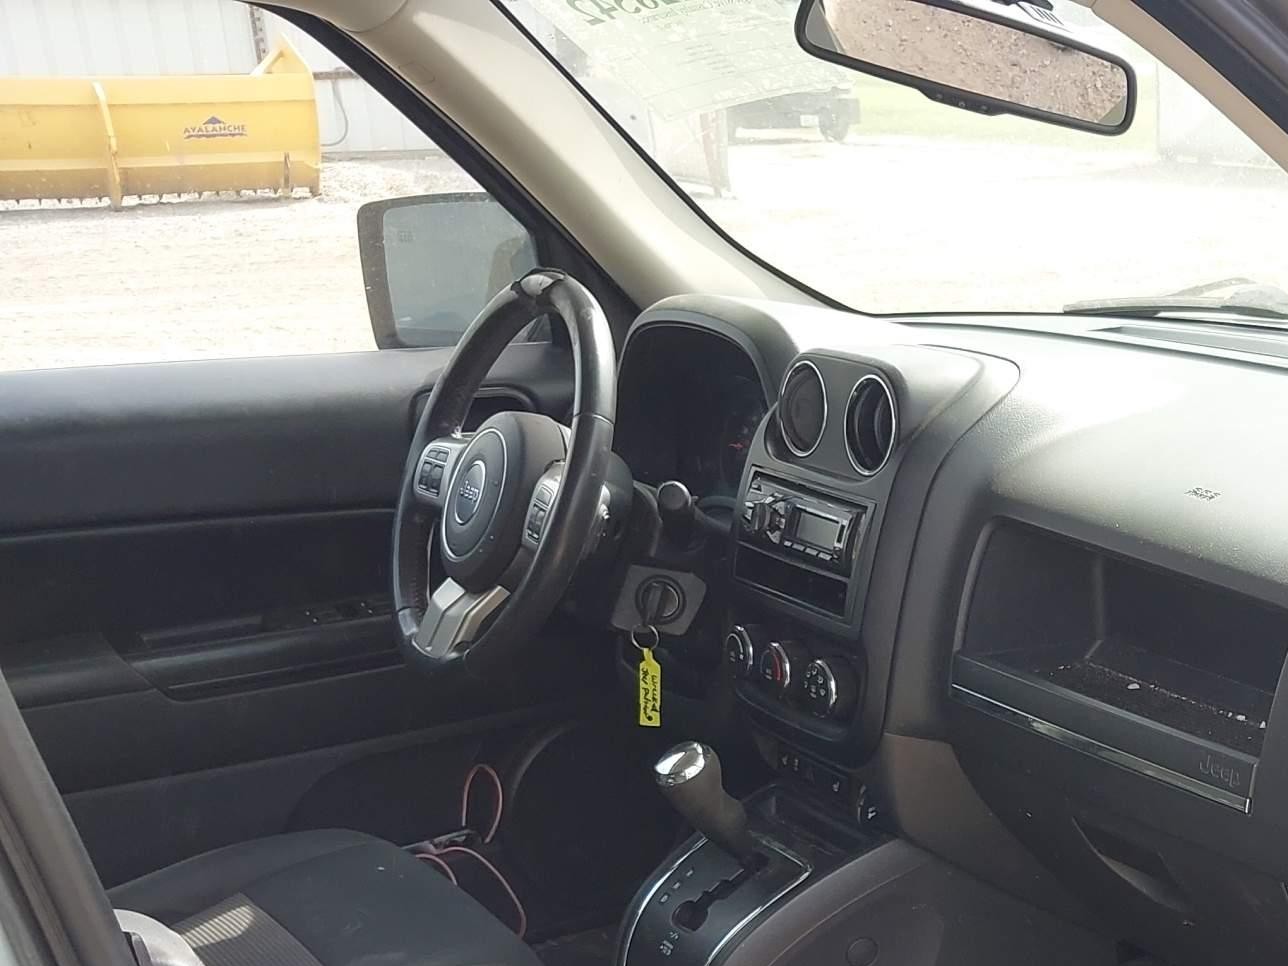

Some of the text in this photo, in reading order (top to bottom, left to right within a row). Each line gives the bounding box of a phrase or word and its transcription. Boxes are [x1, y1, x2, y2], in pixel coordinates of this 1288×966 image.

[183, 124, 248, 135] AVALANCHE
[460, 480, 479, 504] Jeep
[1199, 754, 1240, 787] Jeep
